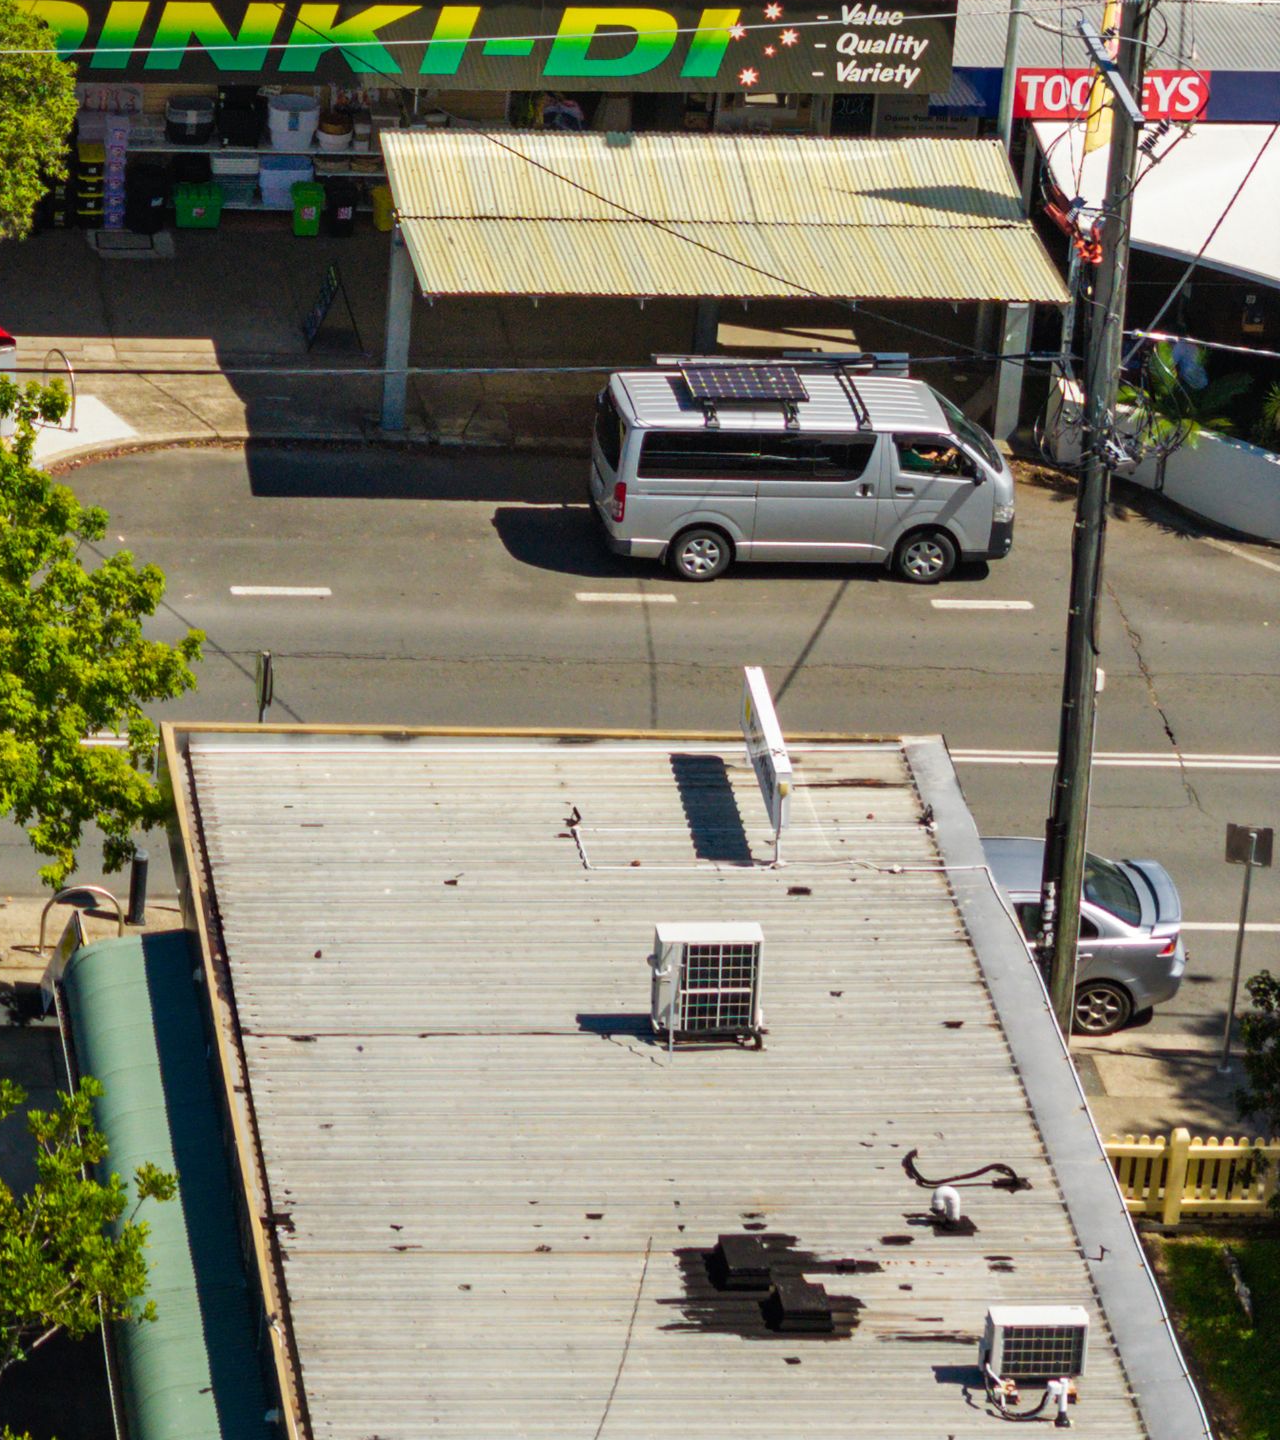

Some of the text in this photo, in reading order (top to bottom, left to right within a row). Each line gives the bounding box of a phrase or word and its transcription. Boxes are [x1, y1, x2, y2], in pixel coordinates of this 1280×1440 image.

[841, 3, 905, 27] Value
[835, 32, 929, 61] Quality
[835, 61, 921, 89] Variety
[1020, 73, 1202, 115] TOOEYS
